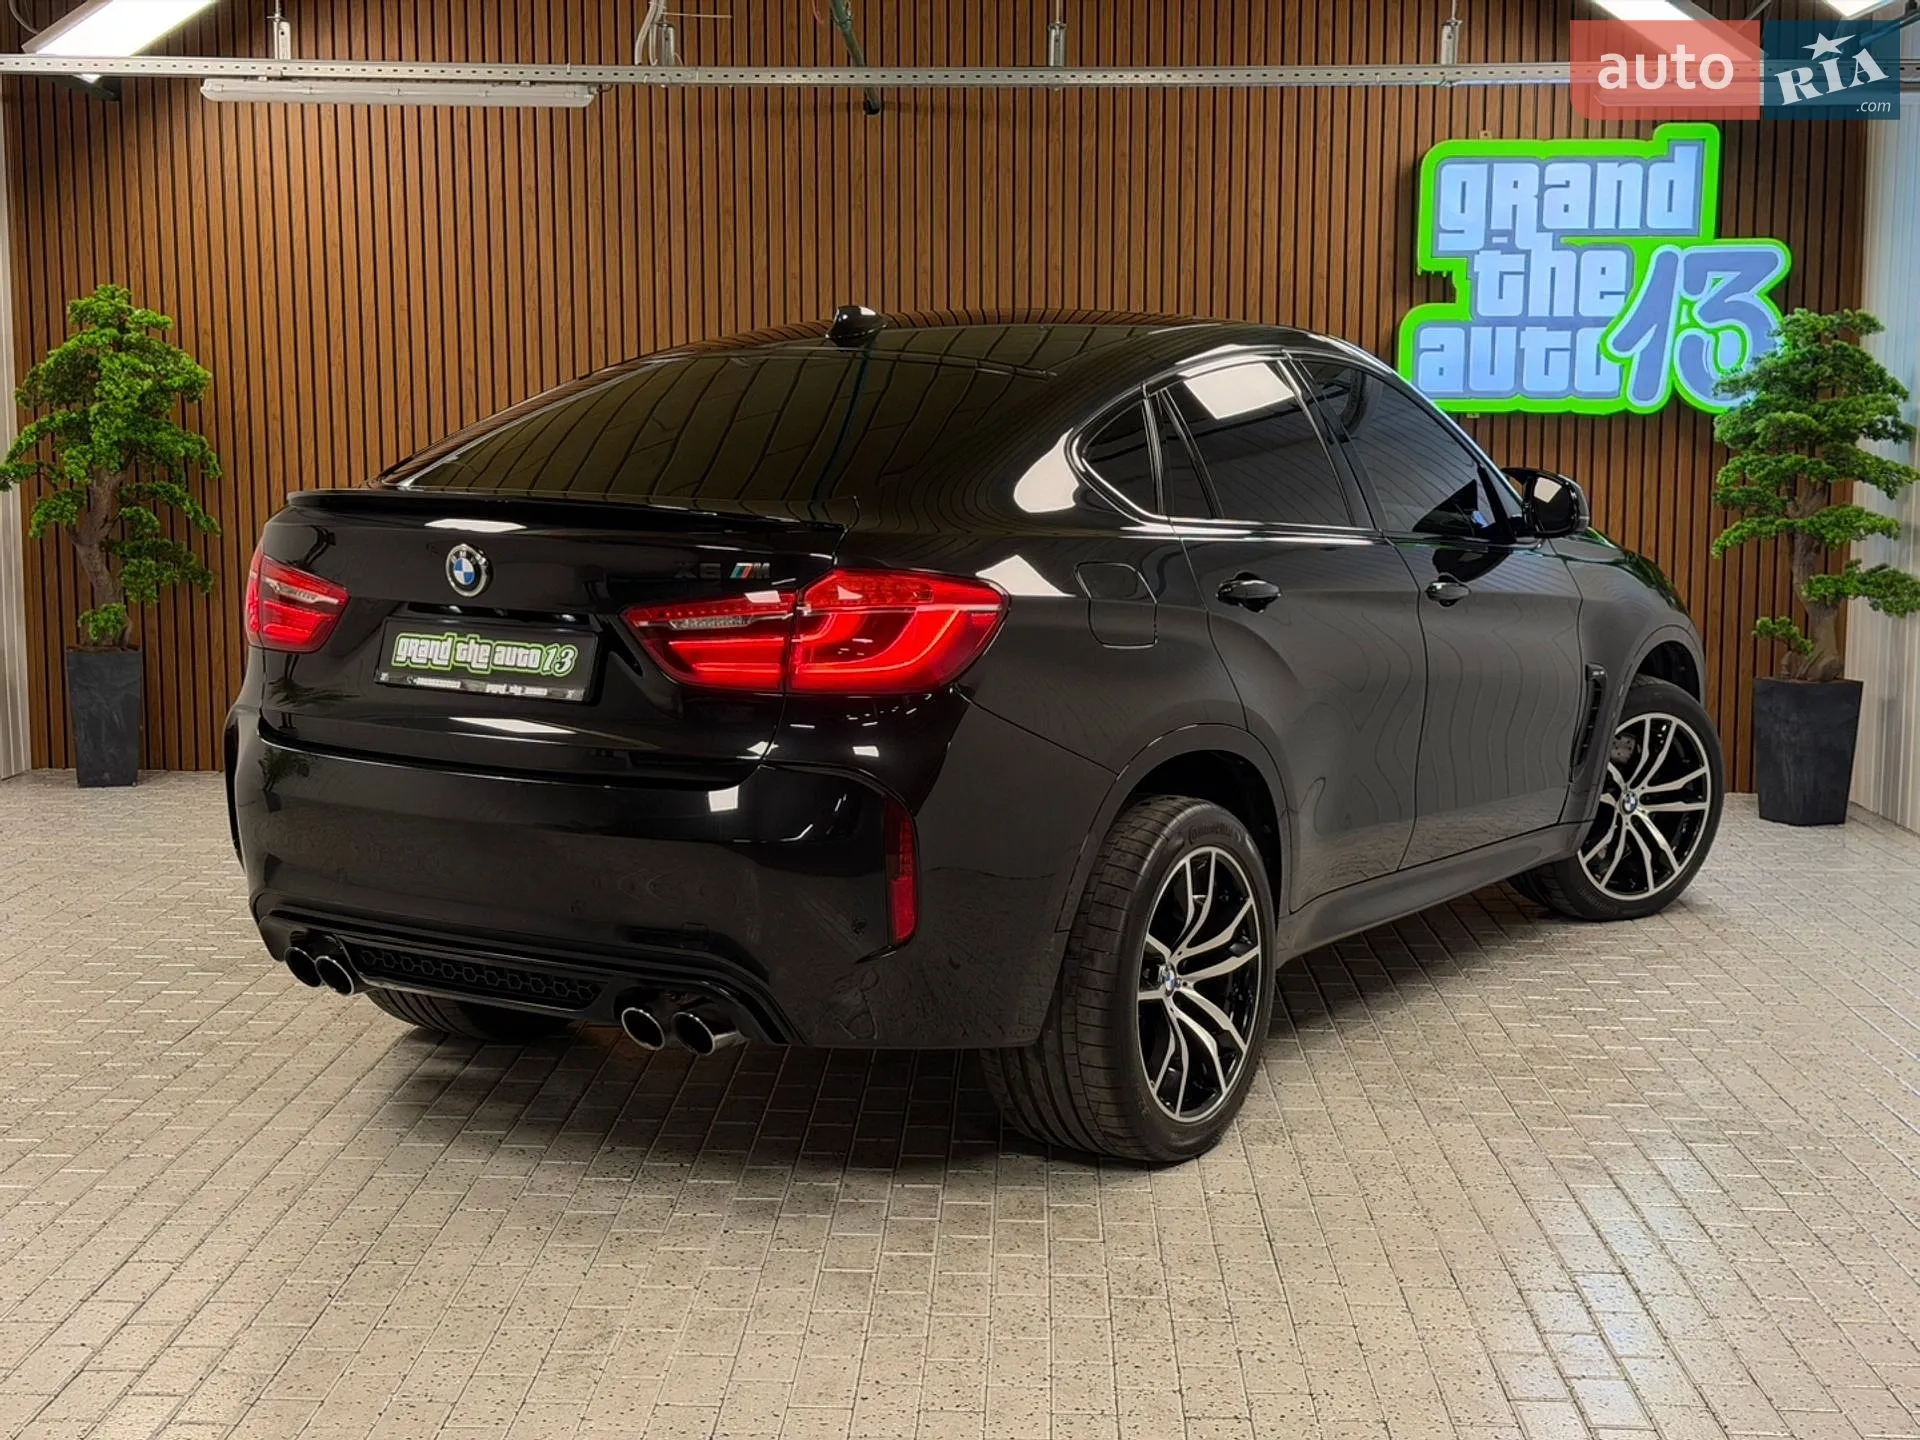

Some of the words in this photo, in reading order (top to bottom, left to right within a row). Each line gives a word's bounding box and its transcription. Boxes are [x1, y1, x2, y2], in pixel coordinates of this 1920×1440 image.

[1473, 238, 1628, 318] the
[1607, 245, 1786, 408] 13
[455, 638, 491, 670] the
[493, 644, 542, 669] auto
[541, 646, 577, 675] 13
